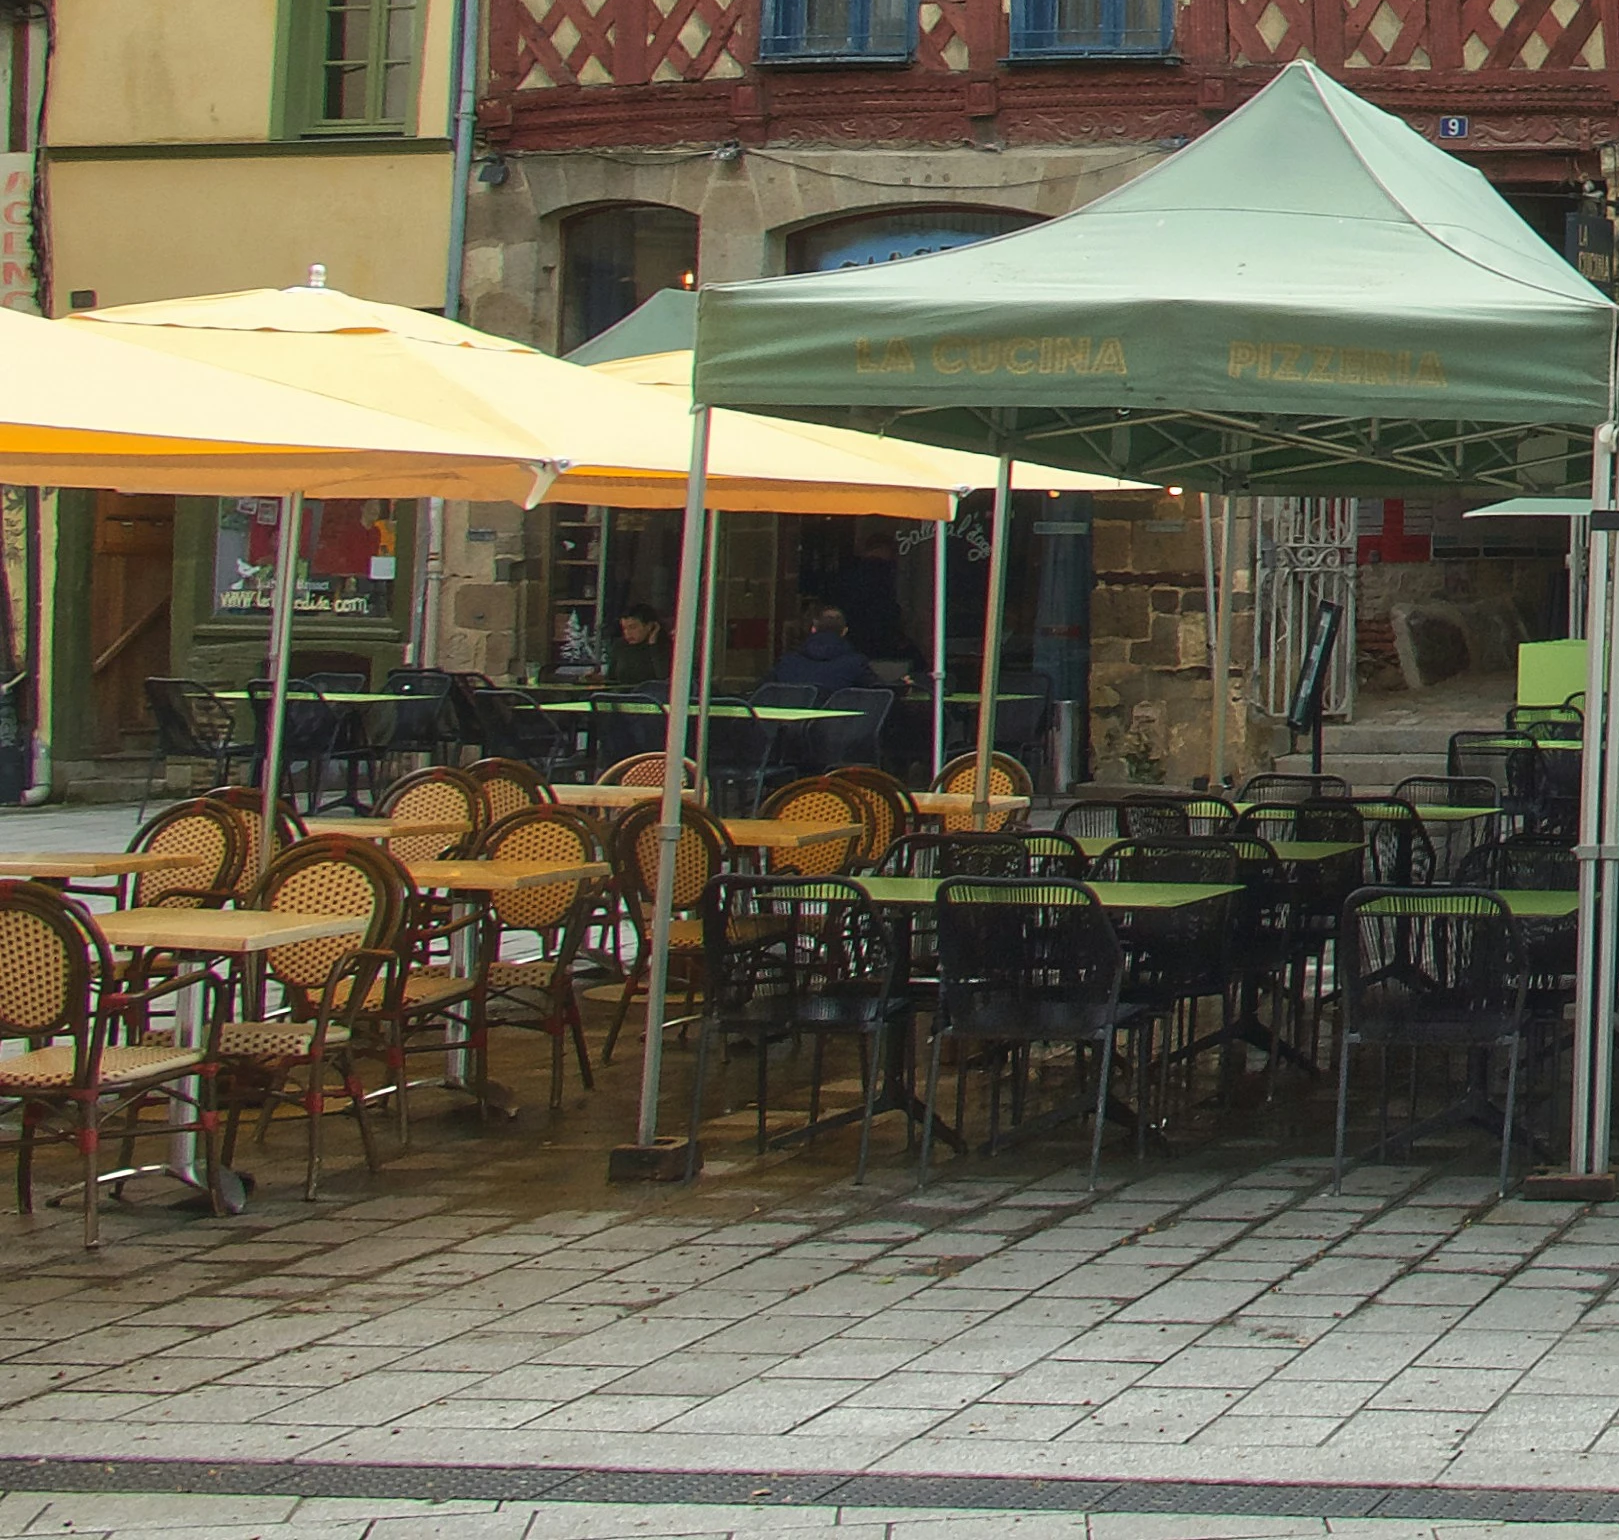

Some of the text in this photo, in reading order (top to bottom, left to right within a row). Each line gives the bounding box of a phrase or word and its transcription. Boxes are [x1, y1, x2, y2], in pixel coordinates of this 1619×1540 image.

[1448, 118, 1460, 136] 9
[855, 335, 1128, 375] LA CUCINA
[1227, 340, 1448, 389] PIZZERIA
